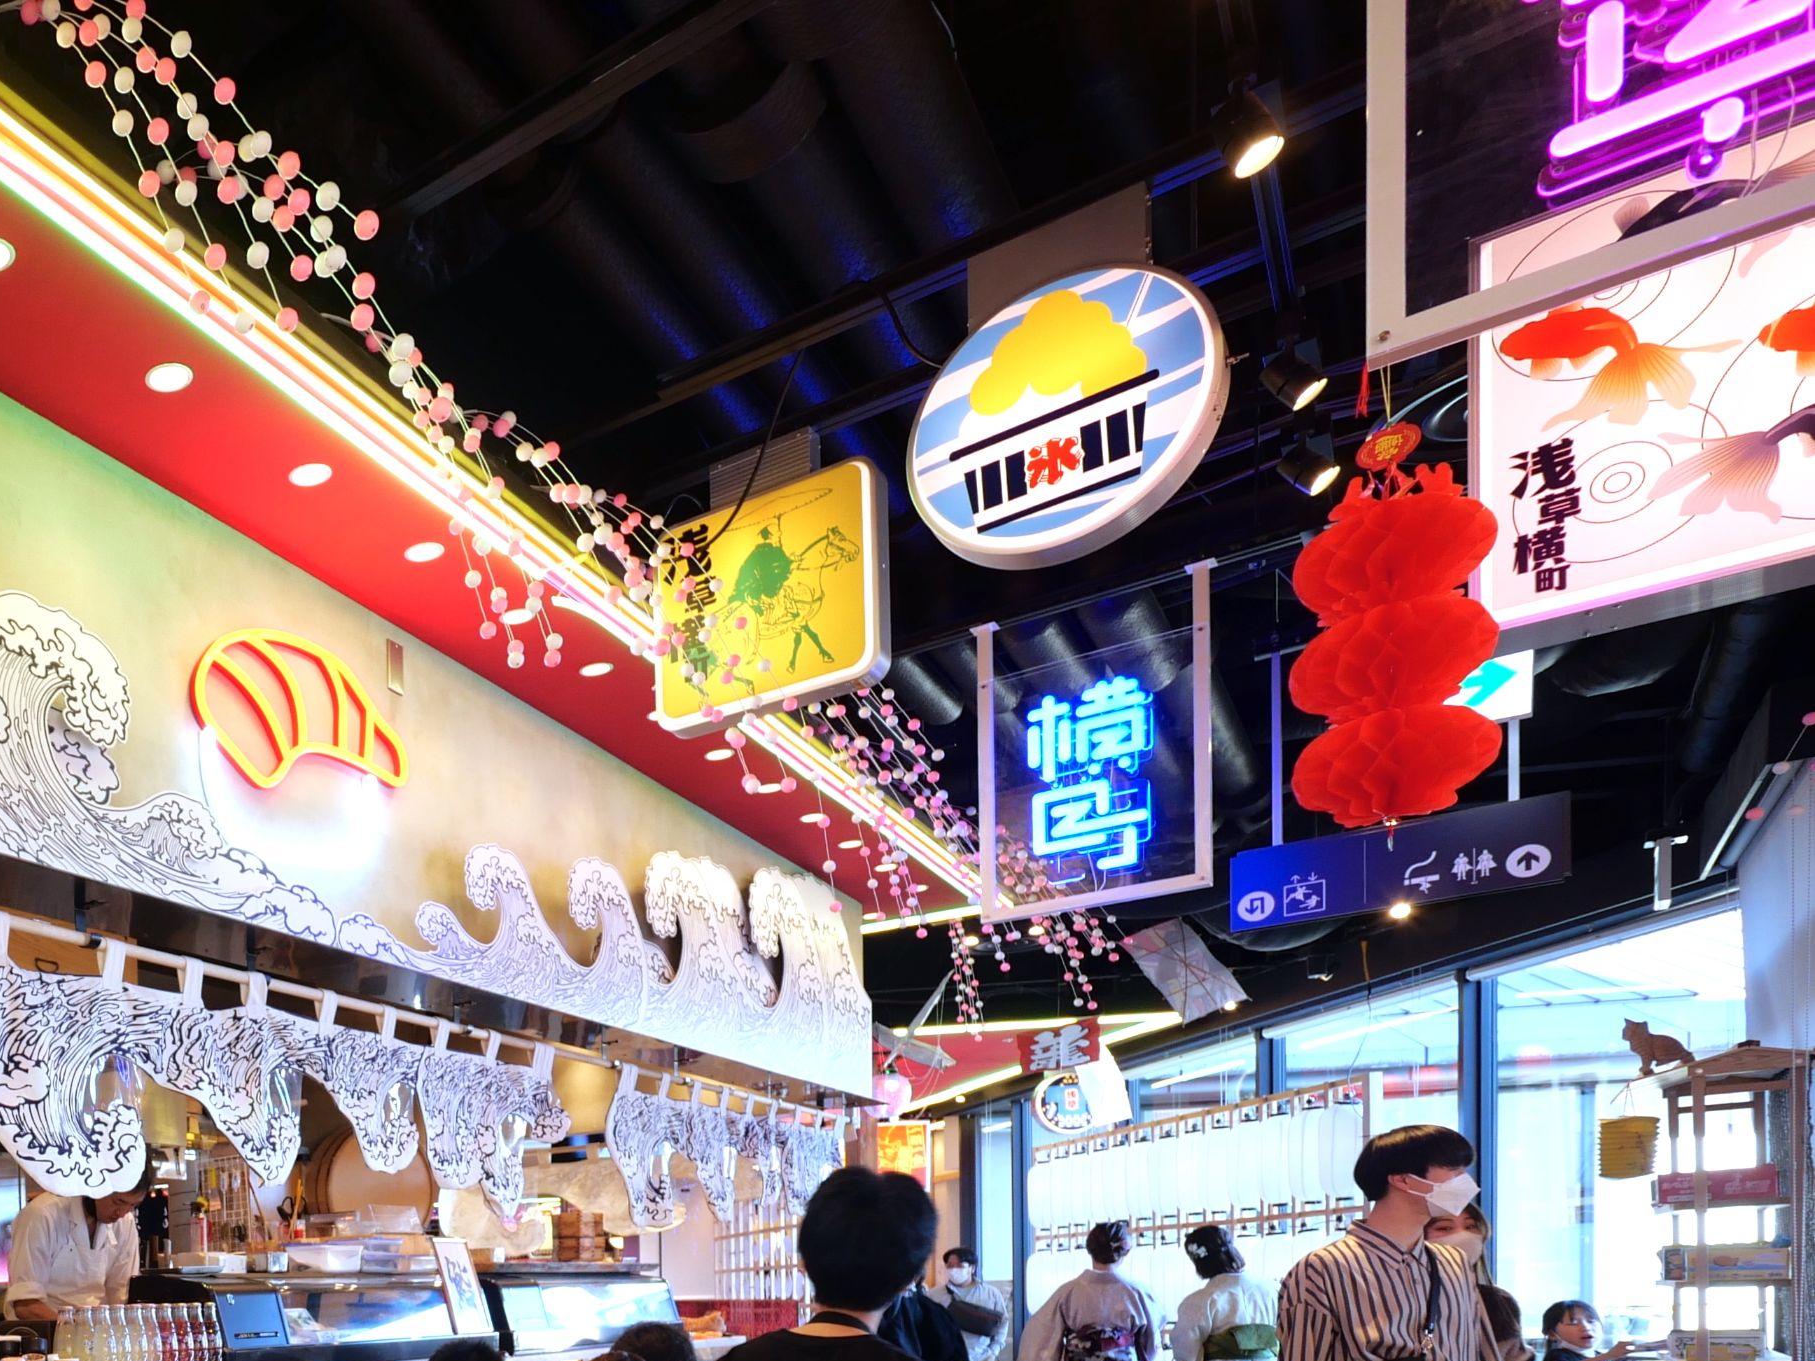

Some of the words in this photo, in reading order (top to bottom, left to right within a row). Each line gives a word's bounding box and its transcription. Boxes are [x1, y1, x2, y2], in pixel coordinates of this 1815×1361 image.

[1026, 436, 1081, 489] 氷
[1508, 437, 1583, 594] 浅草横町
